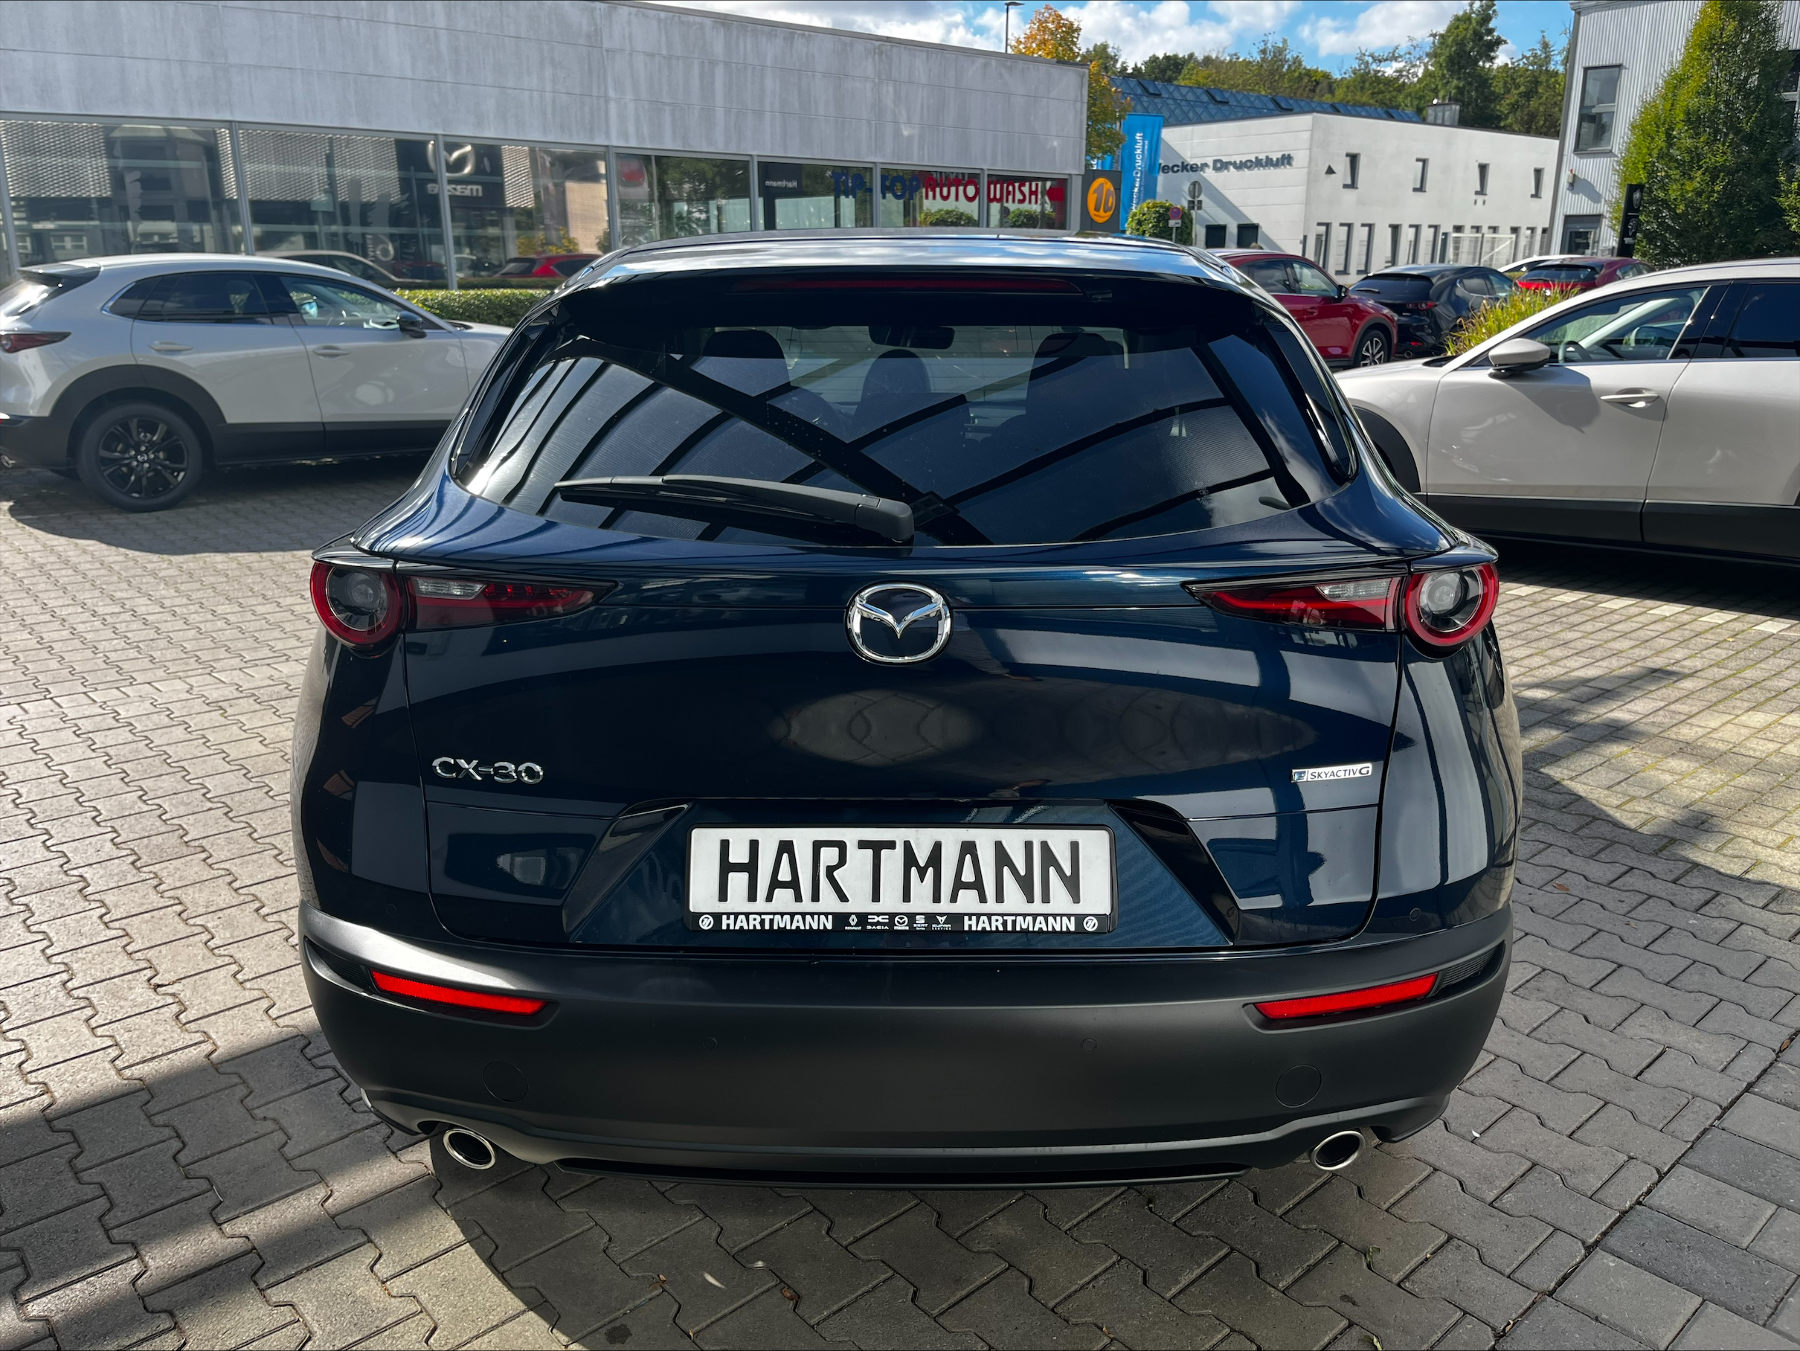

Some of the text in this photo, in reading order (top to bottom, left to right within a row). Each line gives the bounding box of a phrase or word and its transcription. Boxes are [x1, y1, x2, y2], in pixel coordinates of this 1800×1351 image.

[1133, 132, 1143, 177] Druckluft
[1158, 153, 1294, 174] ecker Druckluft
[924, 175, 980, 203] AUTO
[987, 178, 1039, 205] WASH
[432, 757, 544, 784] CX-30
[718, 839, 1080, 904] HARTMANN
[721, 914, 833, 931] HARTMANN
[963, 915, 1076, 932] HARTMANN
